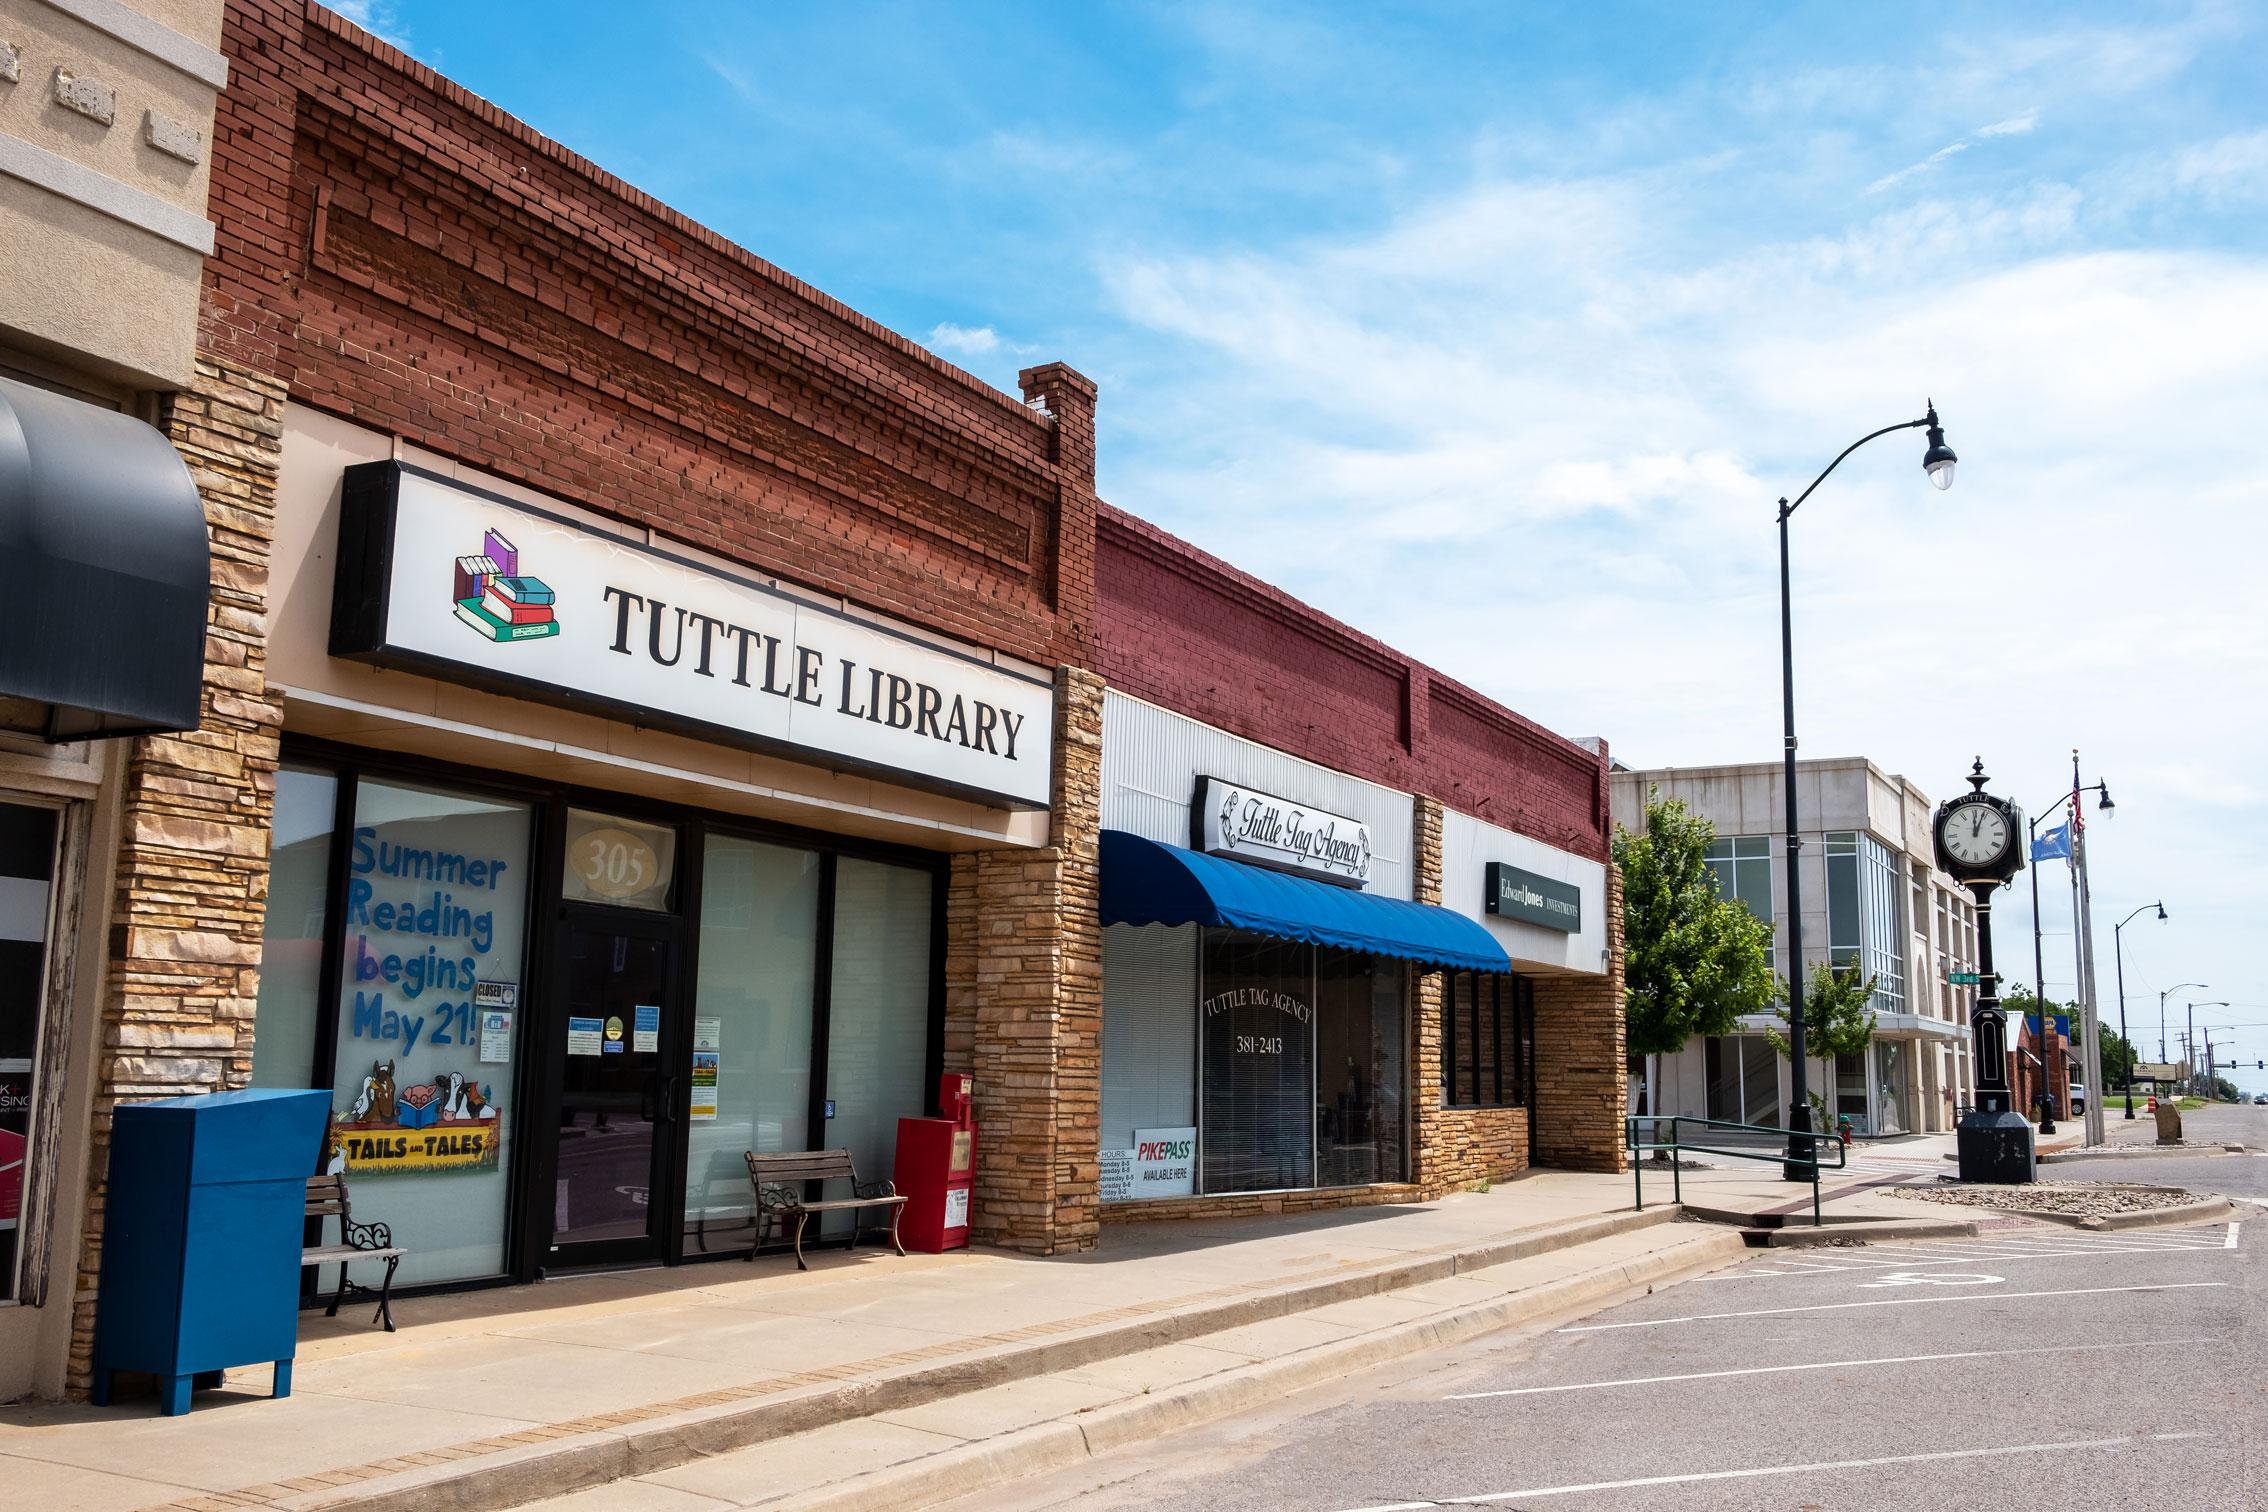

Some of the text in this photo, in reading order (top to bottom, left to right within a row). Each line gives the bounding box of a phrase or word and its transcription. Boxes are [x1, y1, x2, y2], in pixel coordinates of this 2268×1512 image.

[603, 585, 1026, 761] TUTTLE LIBRARY
[1957, 794, 1990, 804] TUTTLE
[1239, 798, 1361, 875] Tuttle Tag Agency
[350, 827, 507, 890] Summer
[586, 839, 645, 886] 305
[347, 878, 493, 954] Reading
[1546, 897, 1579, 917] INVESTMENTS
[356, 935, 476, 999] begins
[1950, 975, 1961, 983] NW
[1961, 975, 1974, 983] 3rd
[477, 983, 502, 997] CLOSED
[1204, 988, 1312, 1024] TUTTLE TAG AGENCY
[354, 992, 476, 1057] May 21!
[1236, 1036, 1282, 1054] 381-2413
[348, 1134, 483, 1160] TAILS AND TALES
[1137, 1140, 1191, 1161] PIKEPASS
[1143, 1168, 1187, 1181] AVAILABLE HERE
